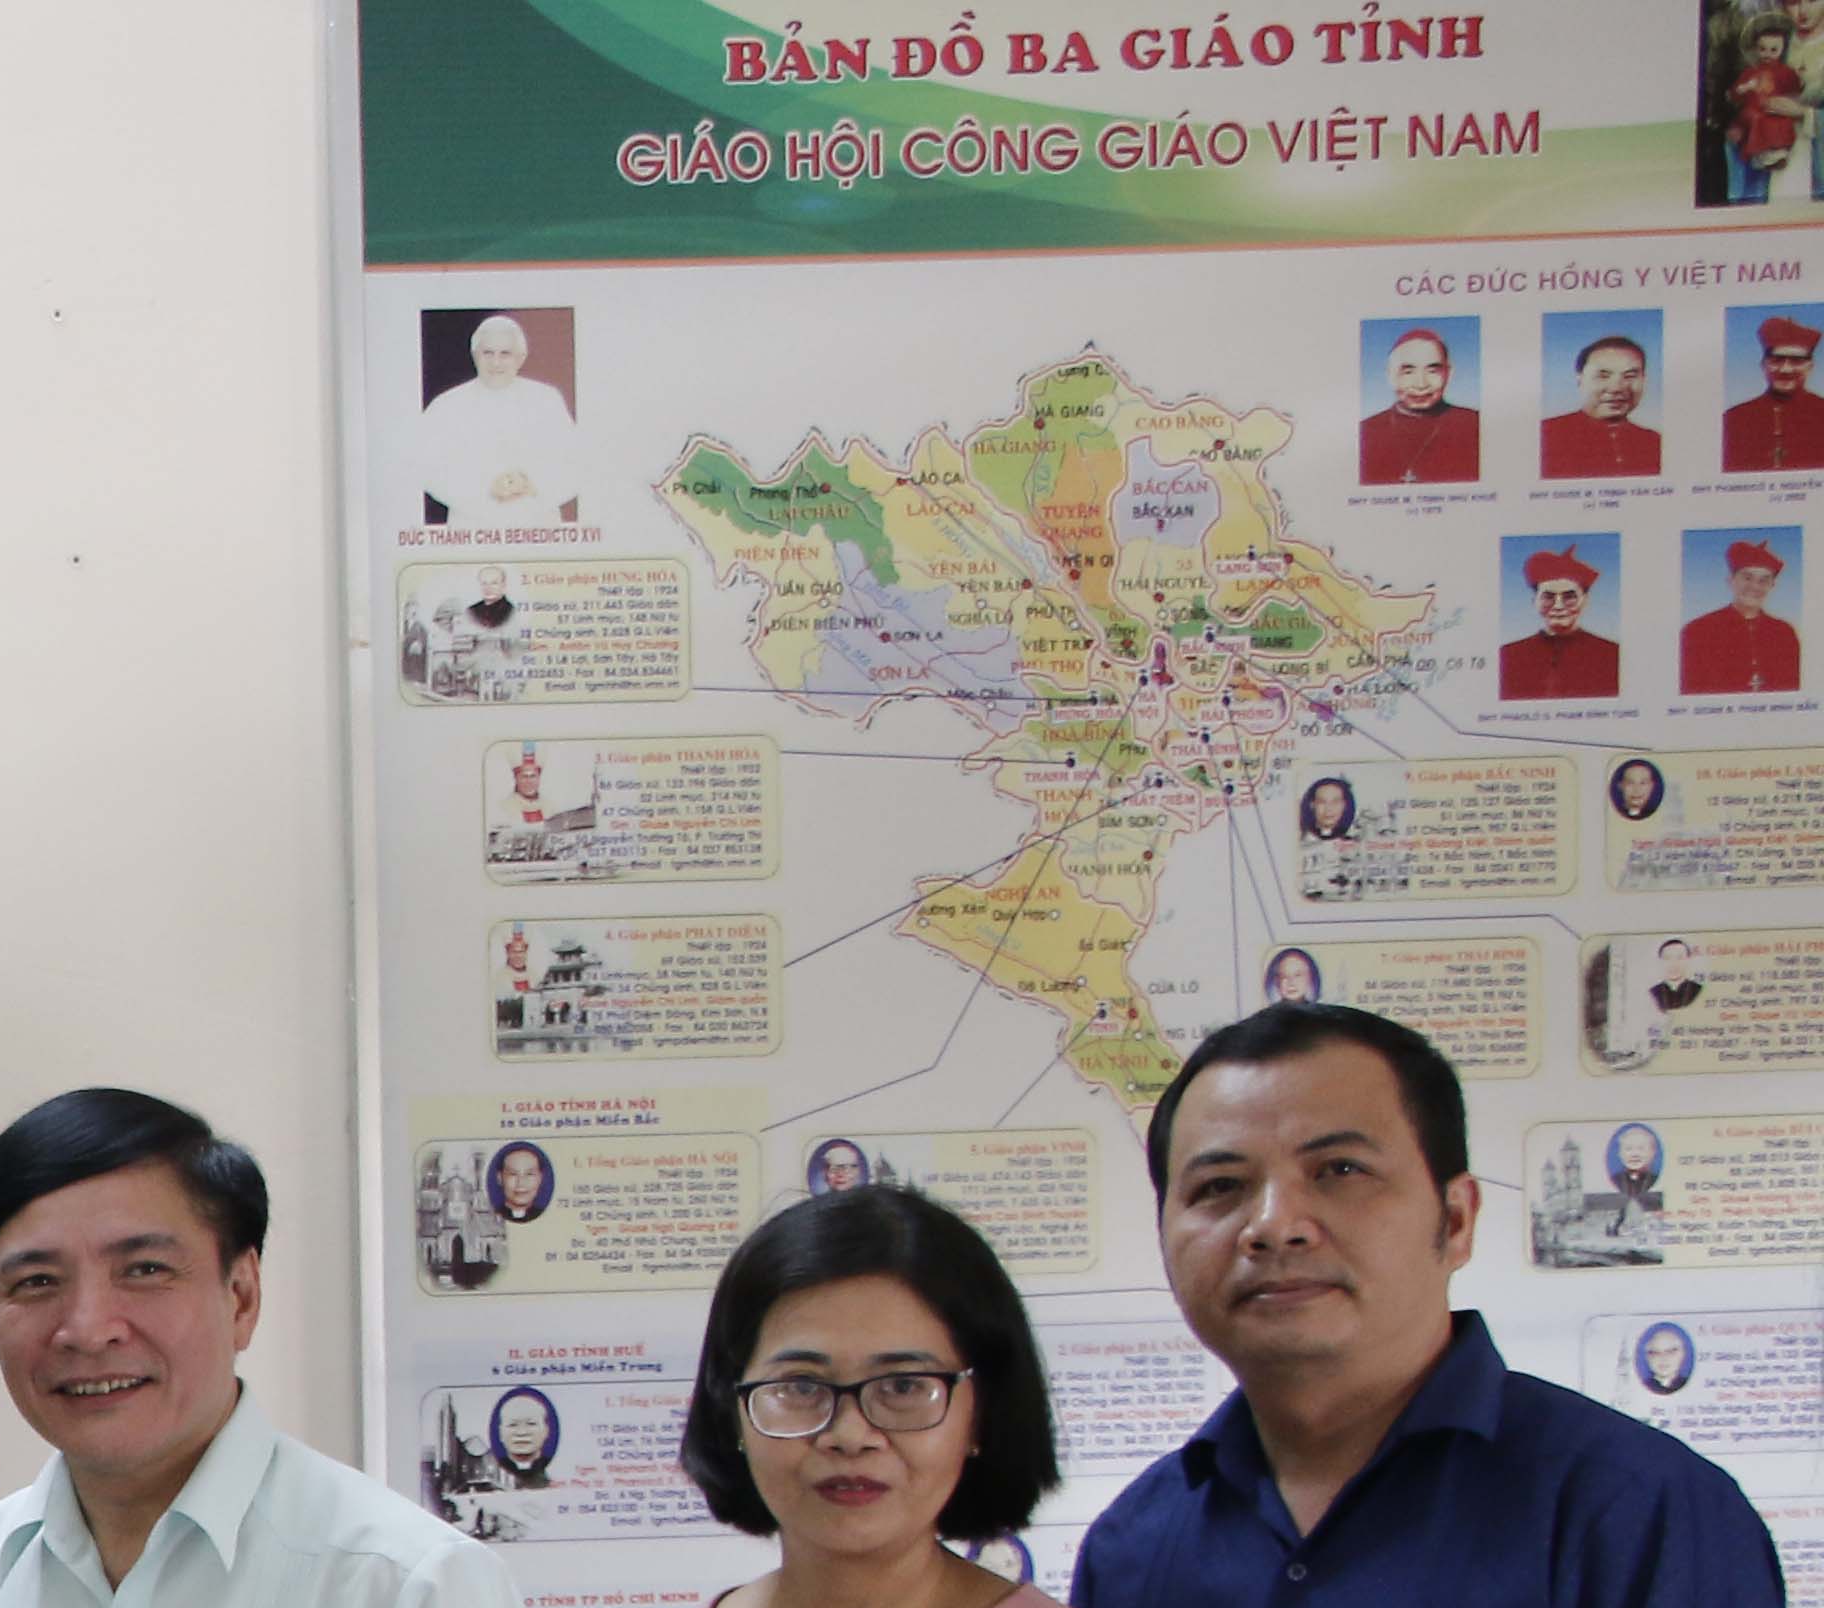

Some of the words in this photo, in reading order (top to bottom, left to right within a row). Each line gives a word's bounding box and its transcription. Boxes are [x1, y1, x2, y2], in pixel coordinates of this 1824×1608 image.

[725, 21, 870, 84] BẢN
[891, 12, 986, 79] ĐỒ
[1006, 30, 1100, 76] BA
[1120, 14, 1295, 72] GIÁO
[1314, 2, 1486, 64] TỈNH
[618, 119, 770, 186] GIÁO
[785, 119, 882, 190] HỘI
[902, 116, 1080, 178] CÔNG
[1097, 111, 1248, 170] GIÁO
[1266, 106, 1388, 172] VIỆT
[1407, 111, 1542, 159] NAM
[1395, 271, 1456, 296] CÁC
[1466, 265, 1528, 294] ĐỨC
[1538, 259, 1624, 291] HỒNG
[1635, 267, 1652, 288] Y
[1663, 259, 1728, 290] VIỆT
[1737, 262, 1802, 283] NAM
